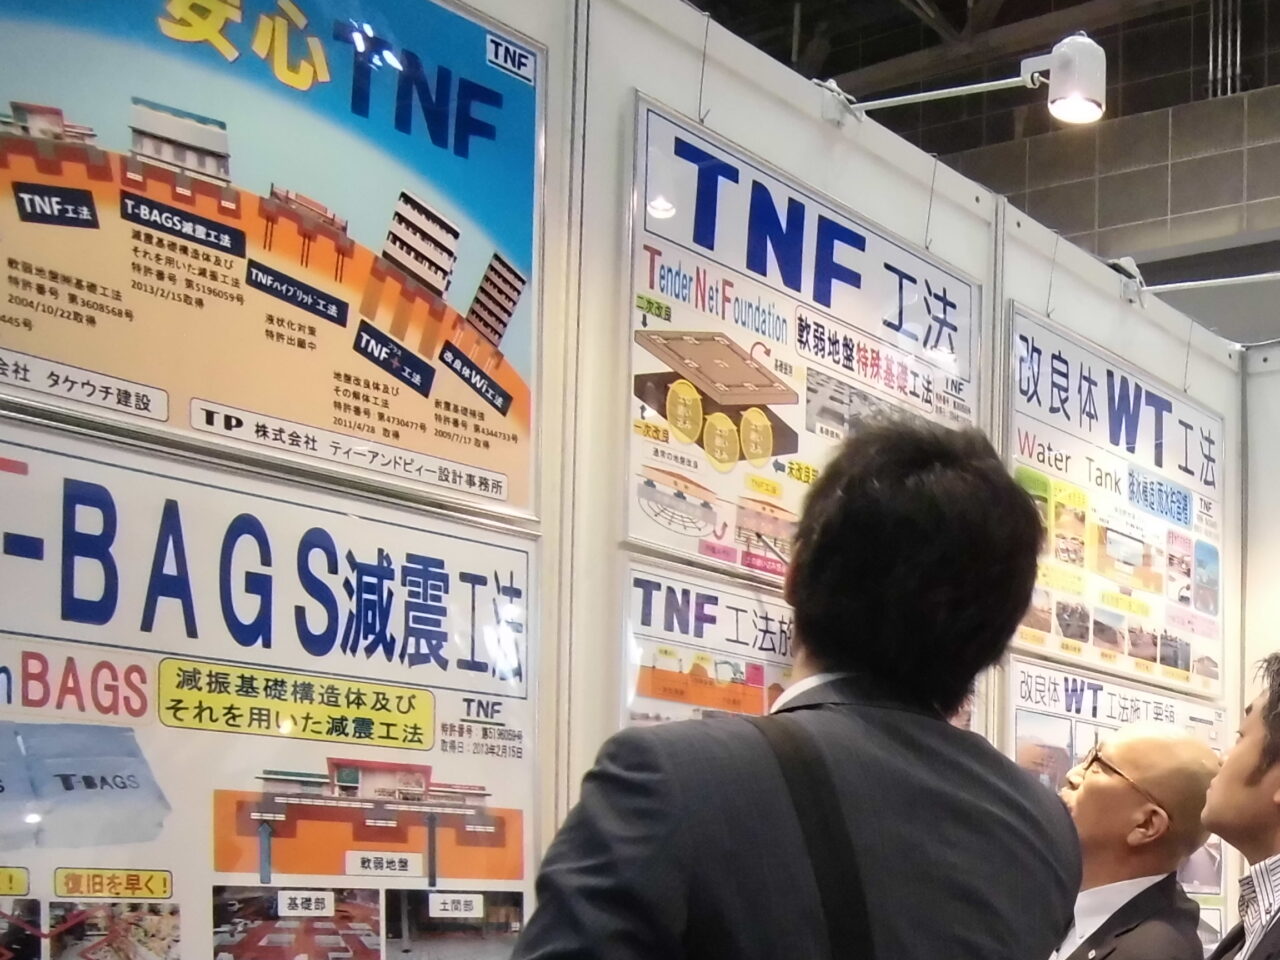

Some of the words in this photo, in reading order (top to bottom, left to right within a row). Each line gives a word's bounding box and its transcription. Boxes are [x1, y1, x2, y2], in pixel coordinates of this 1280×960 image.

[490, 38, 530, 72] TNF
[18, 193, 93, 220] TNF工法
[674, 136, 960, 356] TNF工法
[46, 371, 152, 412] タケウチ建設
[1018, 333, 1217, 490] 改良体WT工法
[199, 406, 244, 432] TP
[253, 420, 319, 452] 株式会社
[1017, 427, 1072, 473] Water
[1084, 456, 1122, 495] Tank
[0, 458, 524, 686] -BAGS減震工法
[165, 697, 425, 745] それを用いた減震工法
[462, 697, 503, 719] TNF
[359, 856, 410, 873] 軟弱地盤
[286, 896, 327, 913] 基礎部
